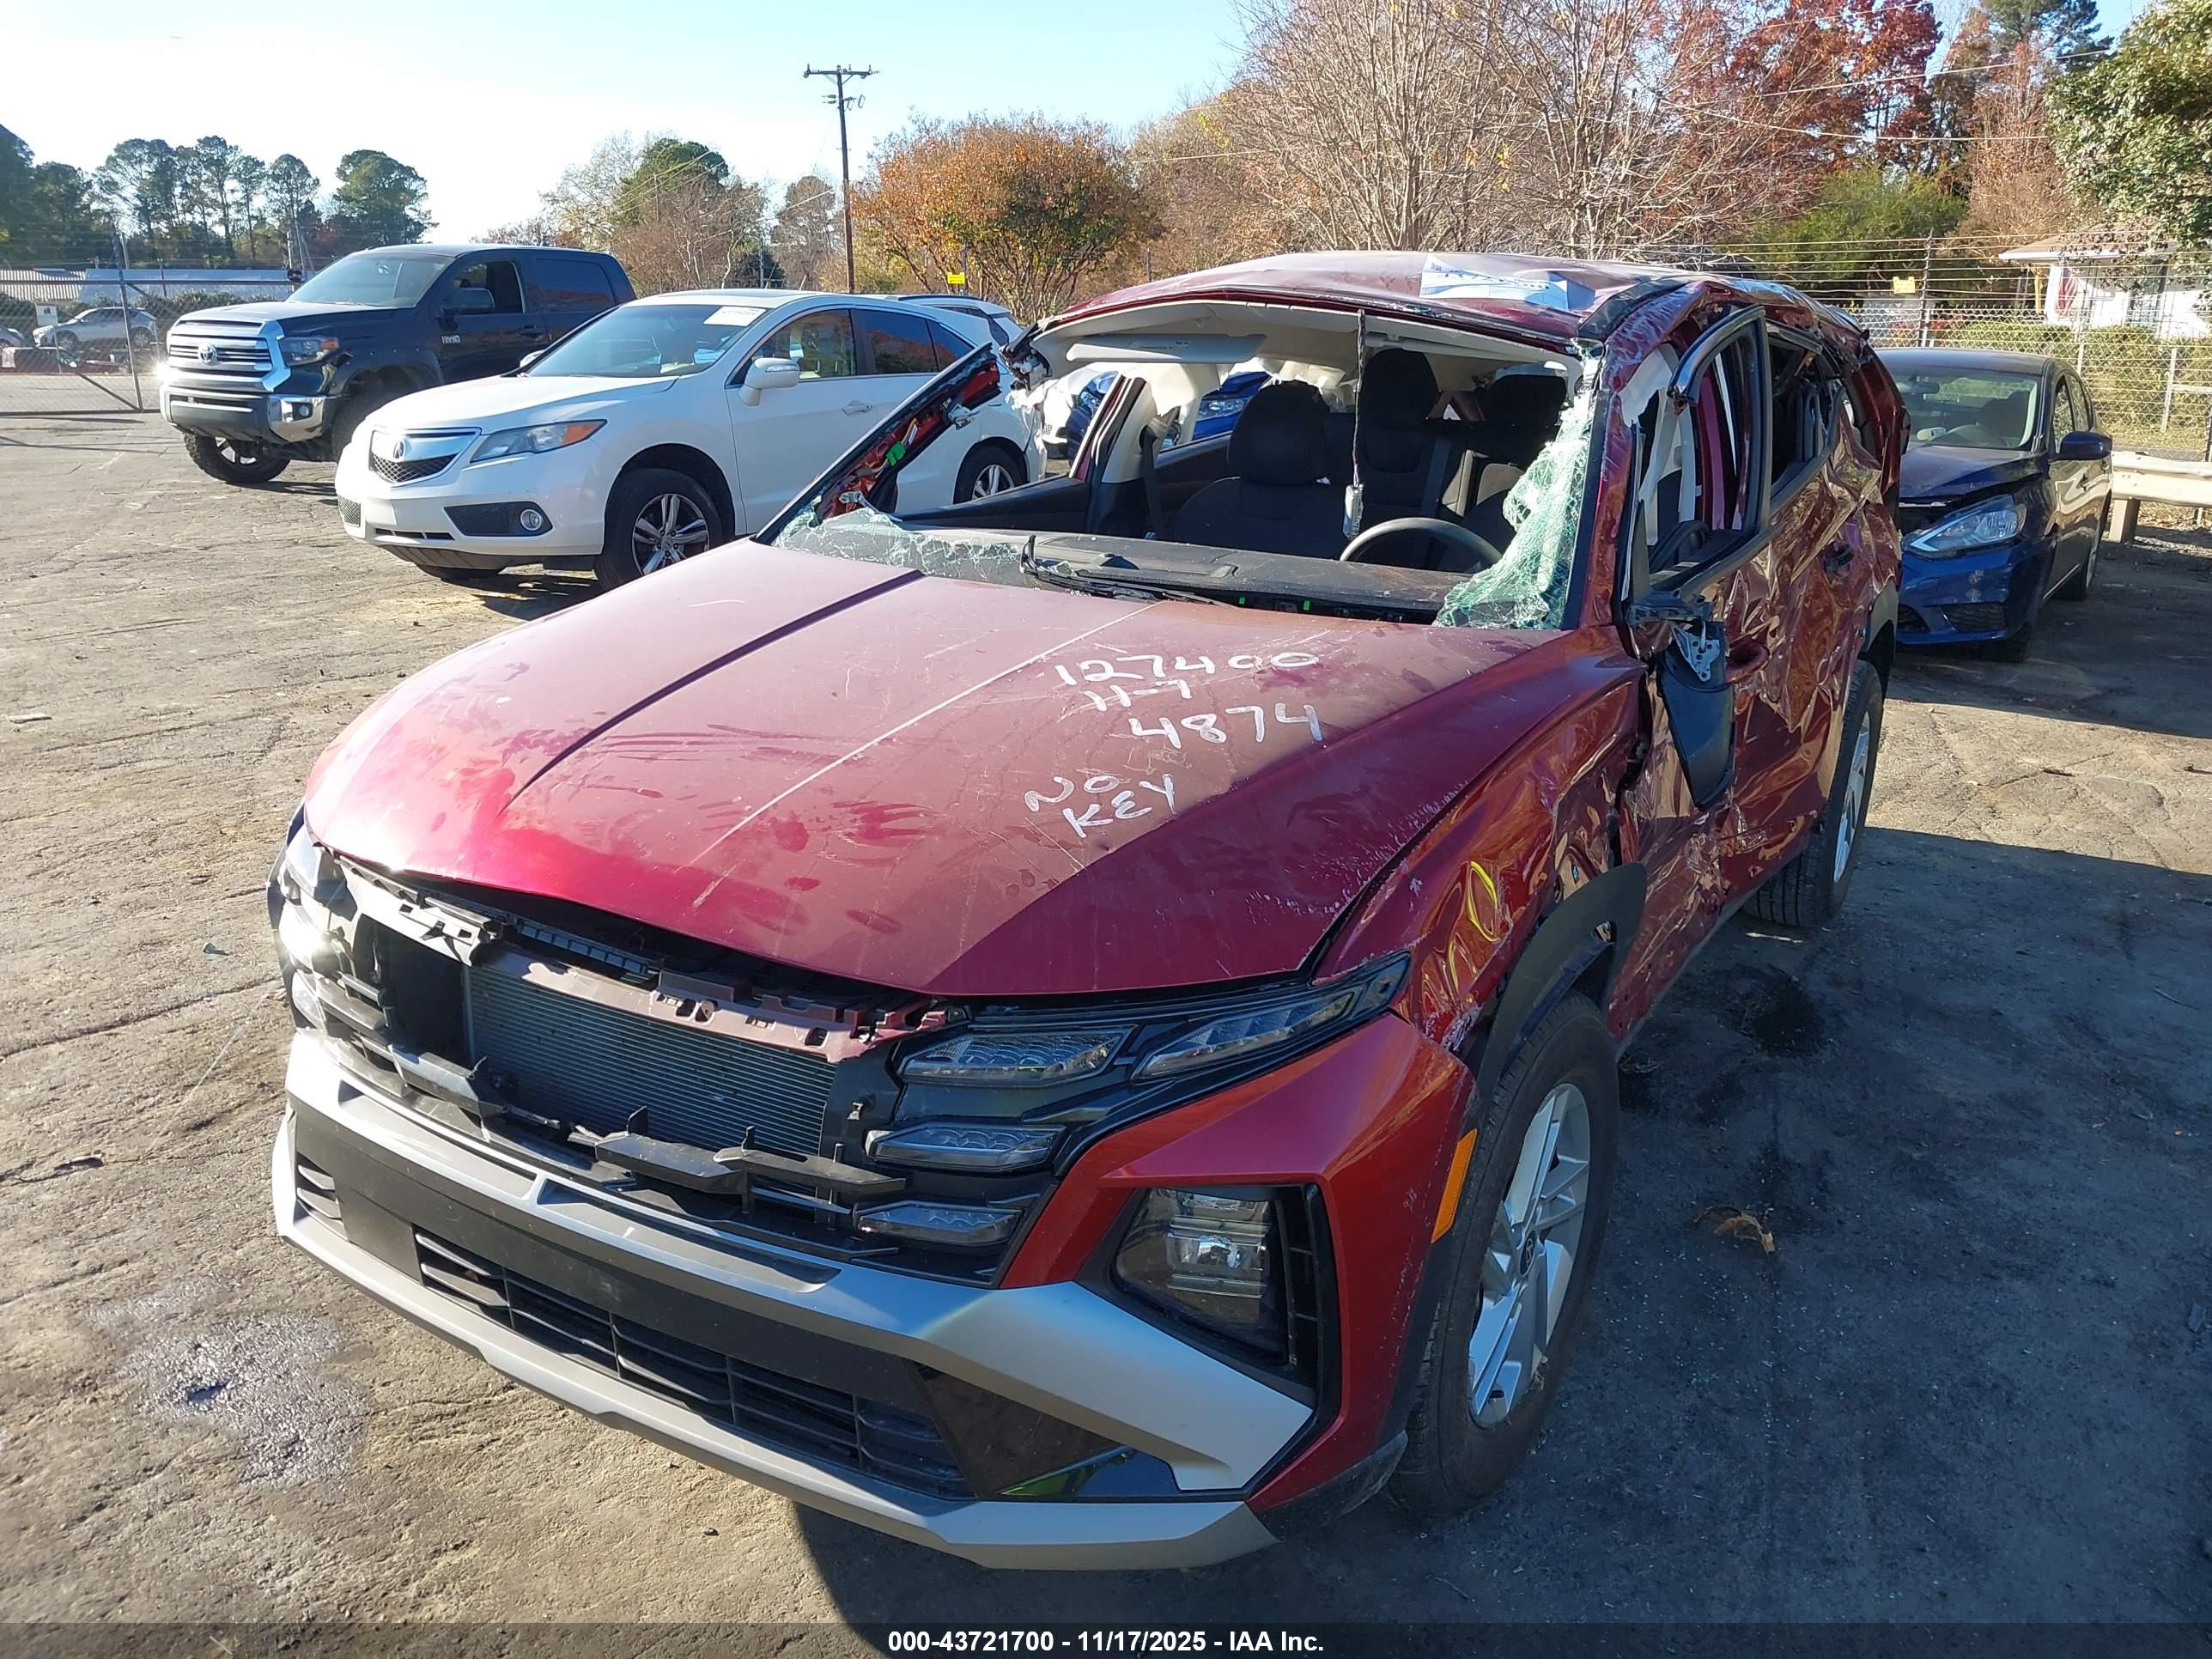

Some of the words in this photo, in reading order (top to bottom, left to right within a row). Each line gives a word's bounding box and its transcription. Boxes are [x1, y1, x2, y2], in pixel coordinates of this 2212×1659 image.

[1054, 652, 1320, 685] 127400
[1128, 702, 1323, 749] 4874
[1062, 773, 1177, 838] KEY
